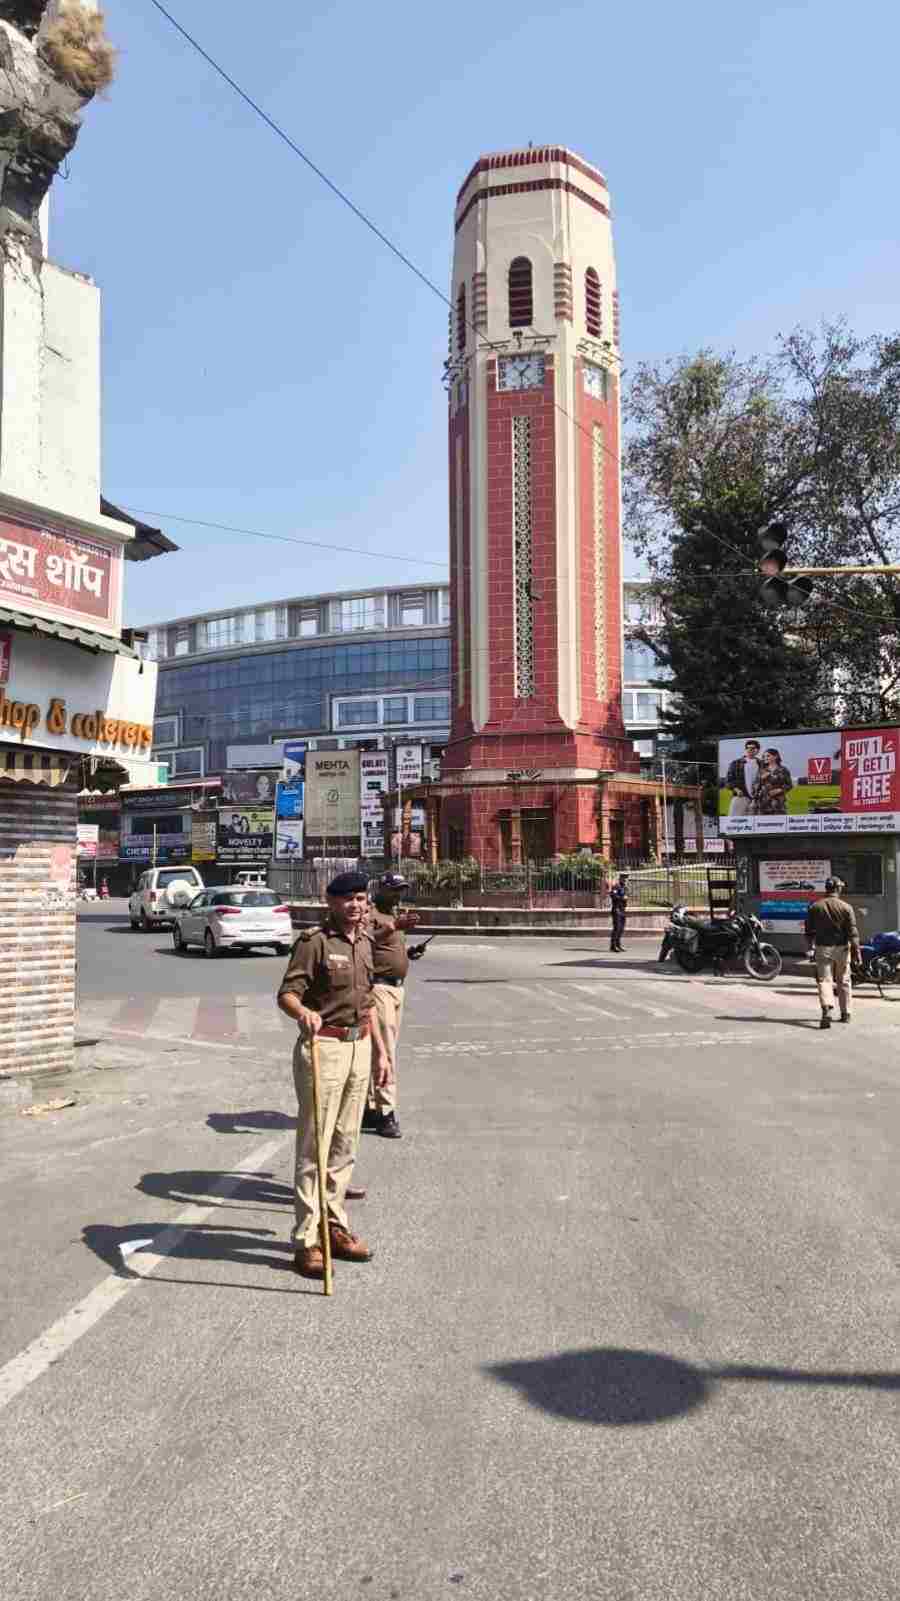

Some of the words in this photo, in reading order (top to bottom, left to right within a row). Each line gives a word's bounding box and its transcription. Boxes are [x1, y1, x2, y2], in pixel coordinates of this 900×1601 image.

[45, 549, 105, 597] शॉप
[848, 741, 869, 758] BUY
[873, 740, 878, 754] 1
[315, 760, 350, 770] MEHTA
[814, 760, 825, 774] V
[863, 756, 882, 772] GET
[885, 756, 890, 770] 1
[853, 774, 891, 799] FREE
[228, 838, 263, 846] NOVELTY
